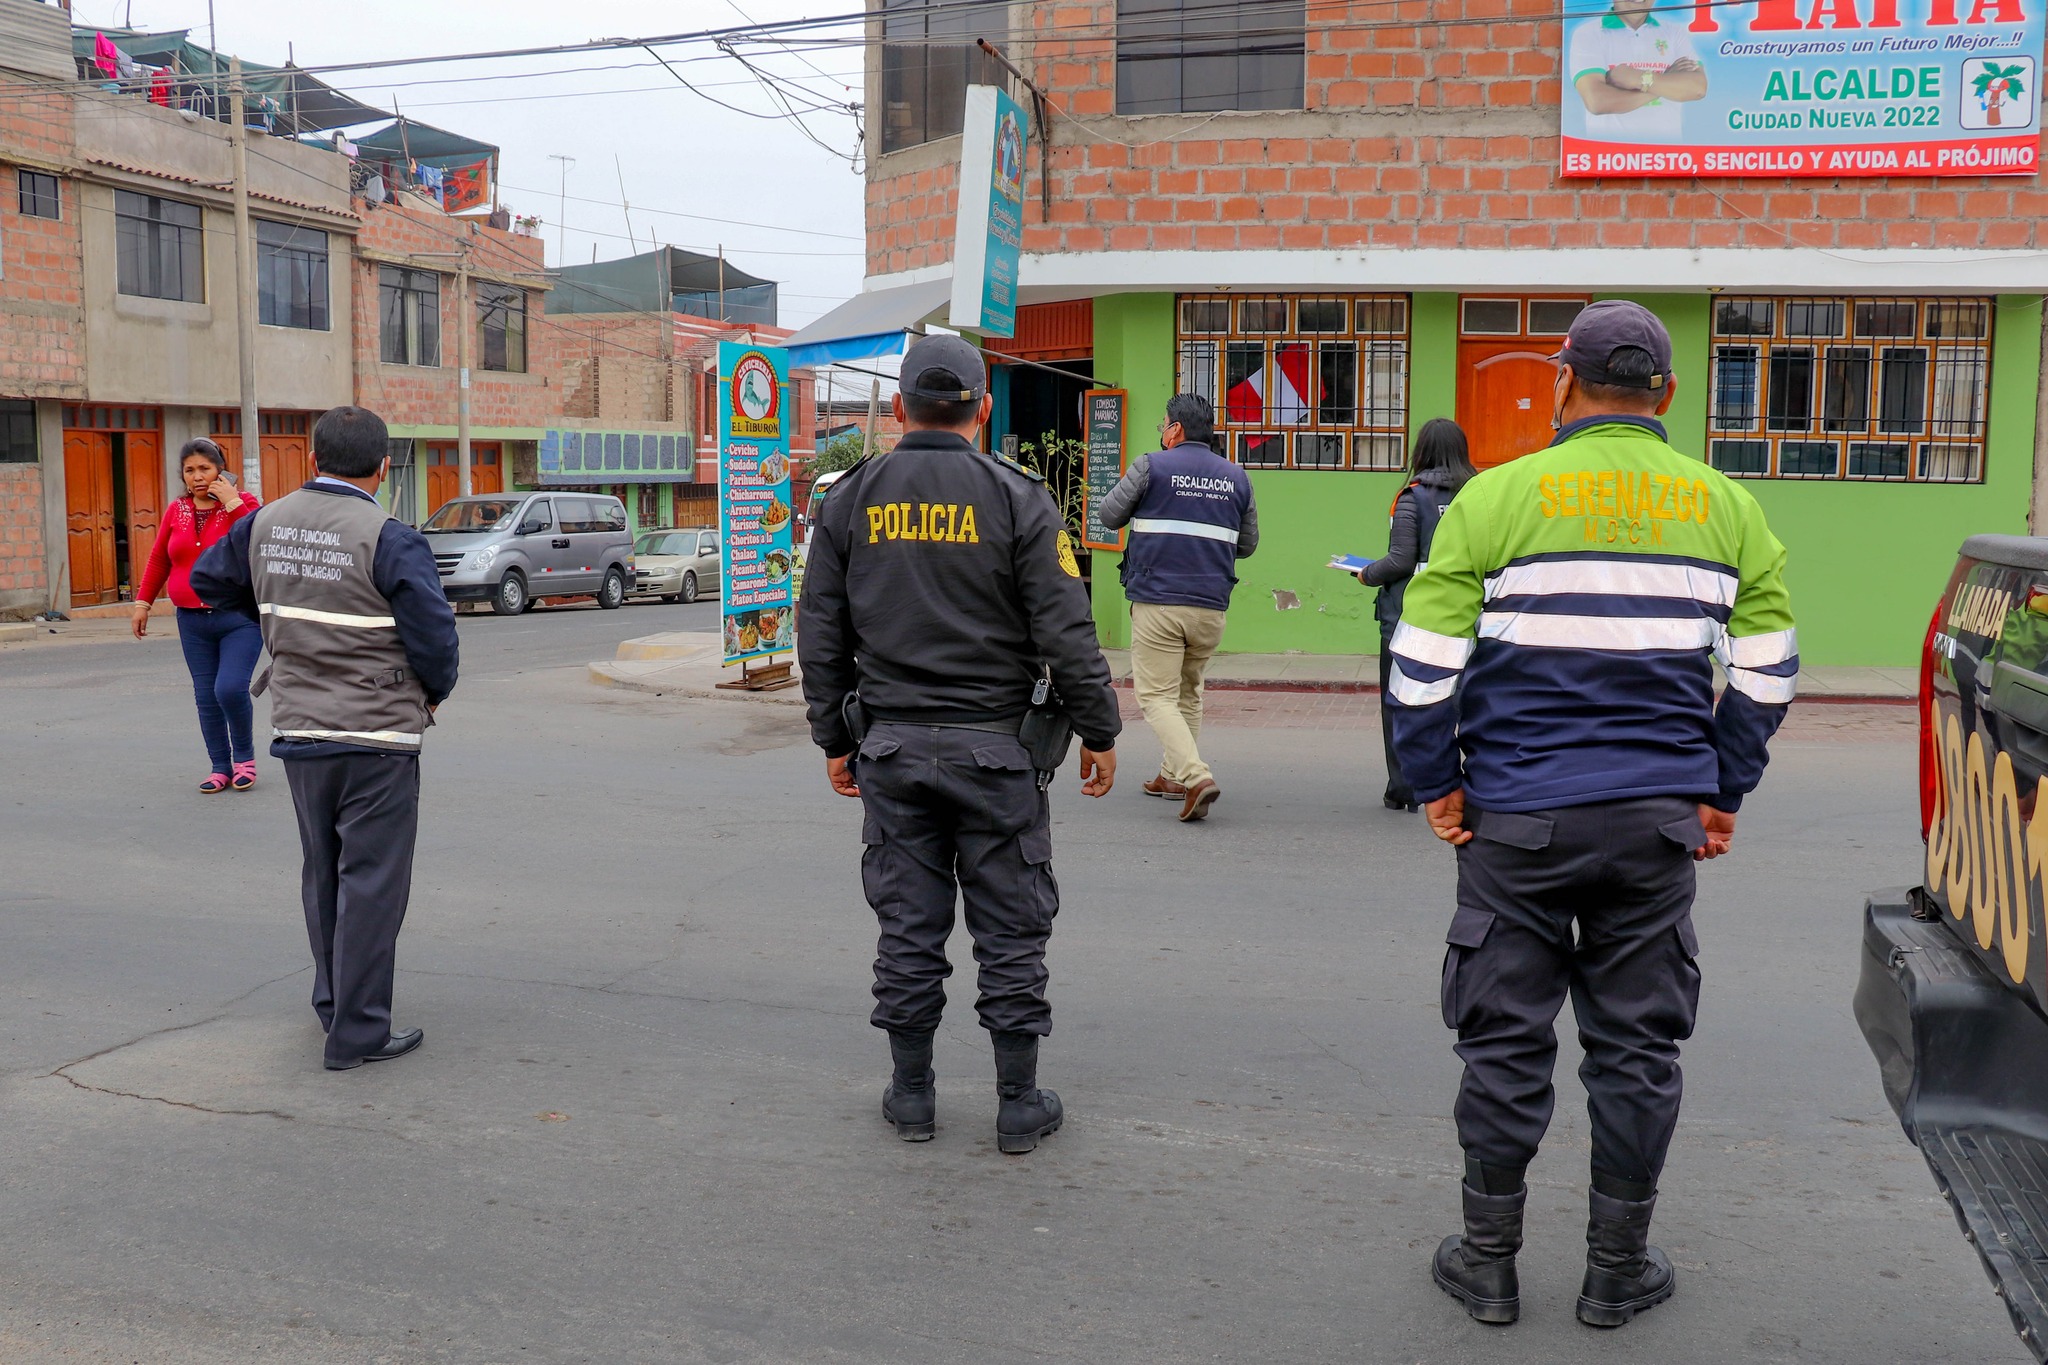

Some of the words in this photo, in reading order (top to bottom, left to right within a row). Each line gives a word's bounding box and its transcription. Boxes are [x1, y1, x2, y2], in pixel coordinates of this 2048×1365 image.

[1719, 40, 1849, 57] Construyamos
[1852, 41, 1874, 52] un
[1879, 37, 1938, 51] Futuro
[1763, 66, 1941, 101] ALCALDE
[1728, 110, 1802, 129] CIUDAD
[1808, 108, 1877, 128] NUEVA
[1883, 105, 1940, 127] 2022
[1566, 154, 1591, 171] ES
[1597, 153, 1698, 174] HONESTO,
[1704, 152, 1803, 170] SENCILLO
[1810, 151, 1825, 169] Y
[1829, 150, 1898, 168] AYUDA
[1904, 149, 1931, 167] AL
[1937, 144, 2033, 166] PRÓJIMO
[1096, 398, 1117, 409] COMBOS
[1094, 410, 1118, 422] MARINOS
[732, 422, 742, 432] EL
[730, 443, 758, 456] Ceviches
[730, 458, 758, 470] Sudados
[730, 473, 765, 486] Parihuelas
[1171, 475, 1234, 493] FISCALIZACIÓN
[730, 488, 774, 501] Chicharrones
[1175, 490, 1203, 498] CIUDAD
[1206, 493, 1229, 501] NUEVA
[1539, 469, 1710, 525] SERENAZGO
[730, 503, 750, 516] Arroz
[751, 505, 764, 515] con
[730, 518, 760, 531] Mariscos
[866, 502, 980, 544] POLICIA
[271, 526, 298, 541] EQUIPO
[300, 529, 341, 546] FUNCIONAL
[730, 533, 760, 546] Choritos
[766, 532, 773, 544] la
[260, 544, 267, 556] DE
[267, 543, 313, 562] FISCALIZACIÓN
[315, 549, 320, 562] Y
[322, 550, 354, 566] CONTROL
[730, 550, 758, 561] Chalaca
[266, 560, 299, 575] MUNICIPAL
[302, 564, 341, 581] ENCARGADO
[731, 563, 756, 576] Picante
[757, 561, 766, 573] de
[732, 578, 767, 590] Camarones
[731, 593, 753, 606] Platos
[753, 588, 787, 604] Especiales
[1947, 582, 2012, 641] LLAMADA
